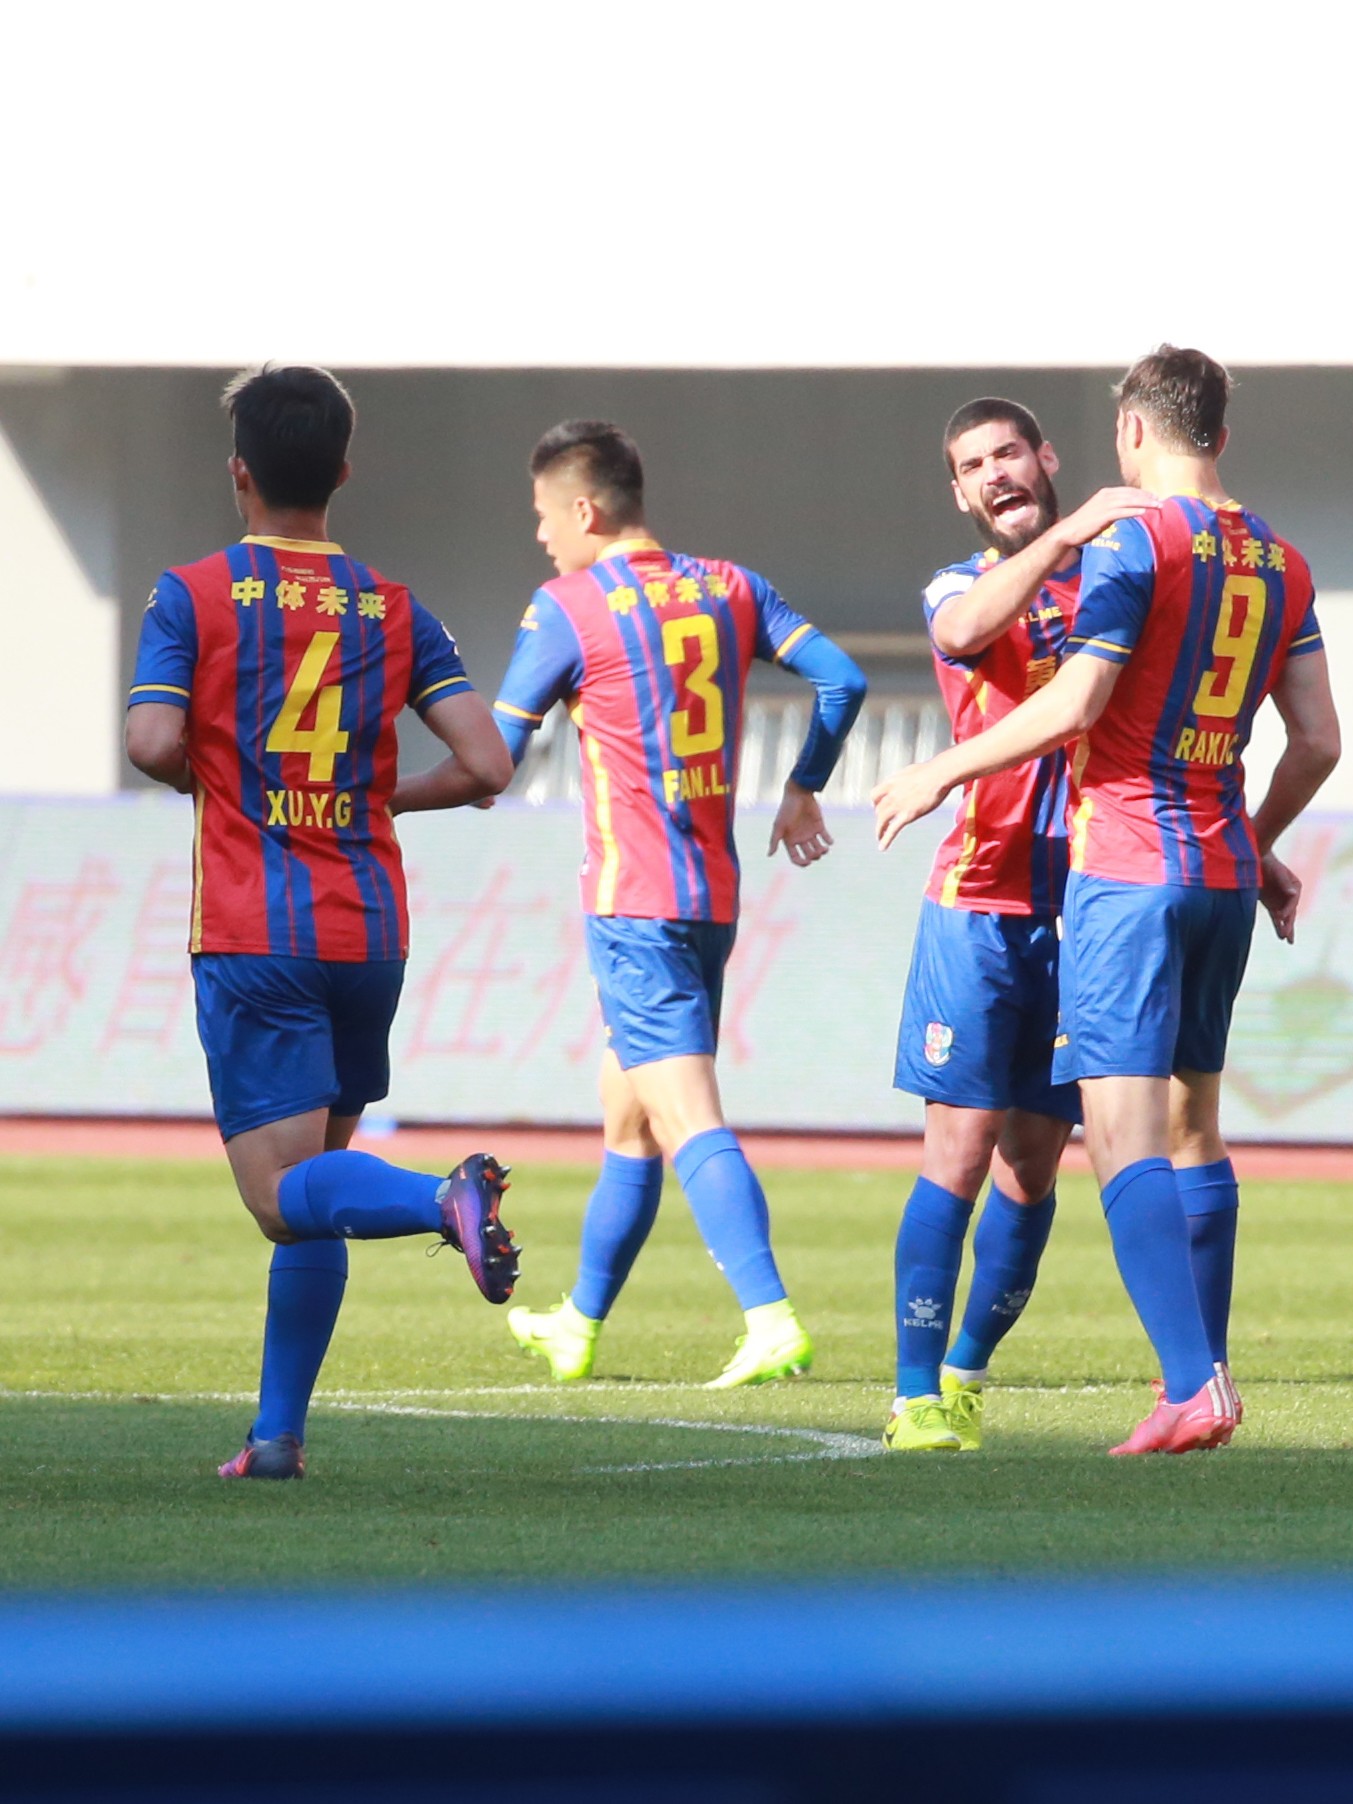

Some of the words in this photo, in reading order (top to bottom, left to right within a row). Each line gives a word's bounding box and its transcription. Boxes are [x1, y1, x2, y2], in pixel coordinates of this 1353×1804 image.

[231, 577, 386, 619] 中体未来
[1192, 574, 1267, 718] 9
[266, 631, 349, 782] 4
[662, 614, 724, 757] 3
[267, 790, 351, 829] XU.Y.G
